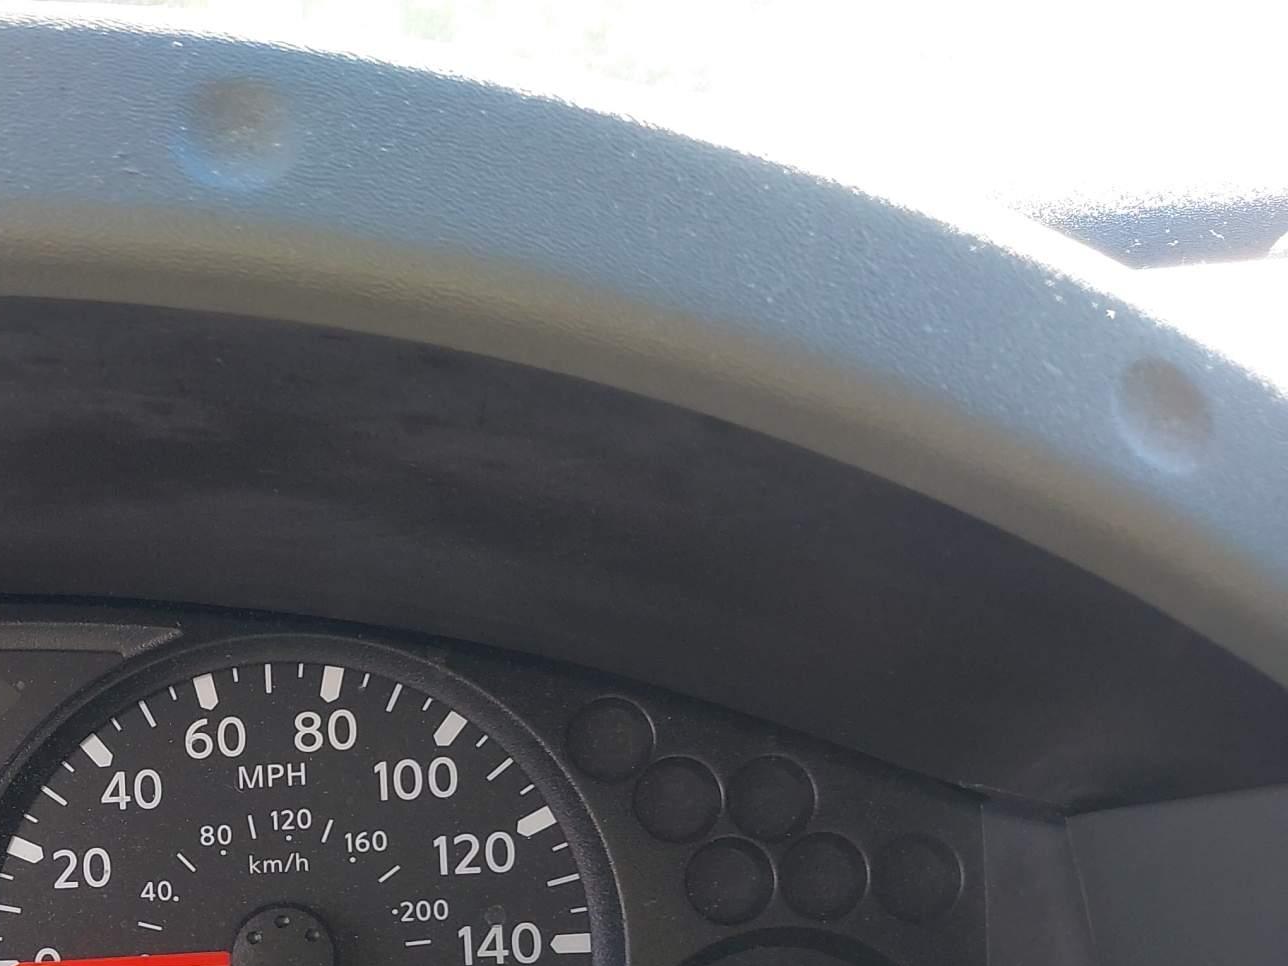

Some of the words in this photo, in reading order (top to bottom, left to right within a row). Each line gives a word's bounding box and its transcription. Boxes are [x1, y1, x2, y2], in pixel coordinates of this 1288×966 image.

[185, 716, 246, 760] 60
[294, 709, 357, 753] 80
[101, 769, 162, 810] 40
[238, 762, 306, 789] MPH
[374, 756, 458, 801] 100
[200, 824, 232, 846] 80
[270, 808, 312, 831] 120
[344, 830, 387, 853] 160
[433, 830, 516, 876] 120
[53, 847, 111, 889] 20
[249, 852, 309, 874] km/h
[140, 880, 172, 902] 40
[400, 899, 449, 922] 200
[458, 922, 542, 966] 140
